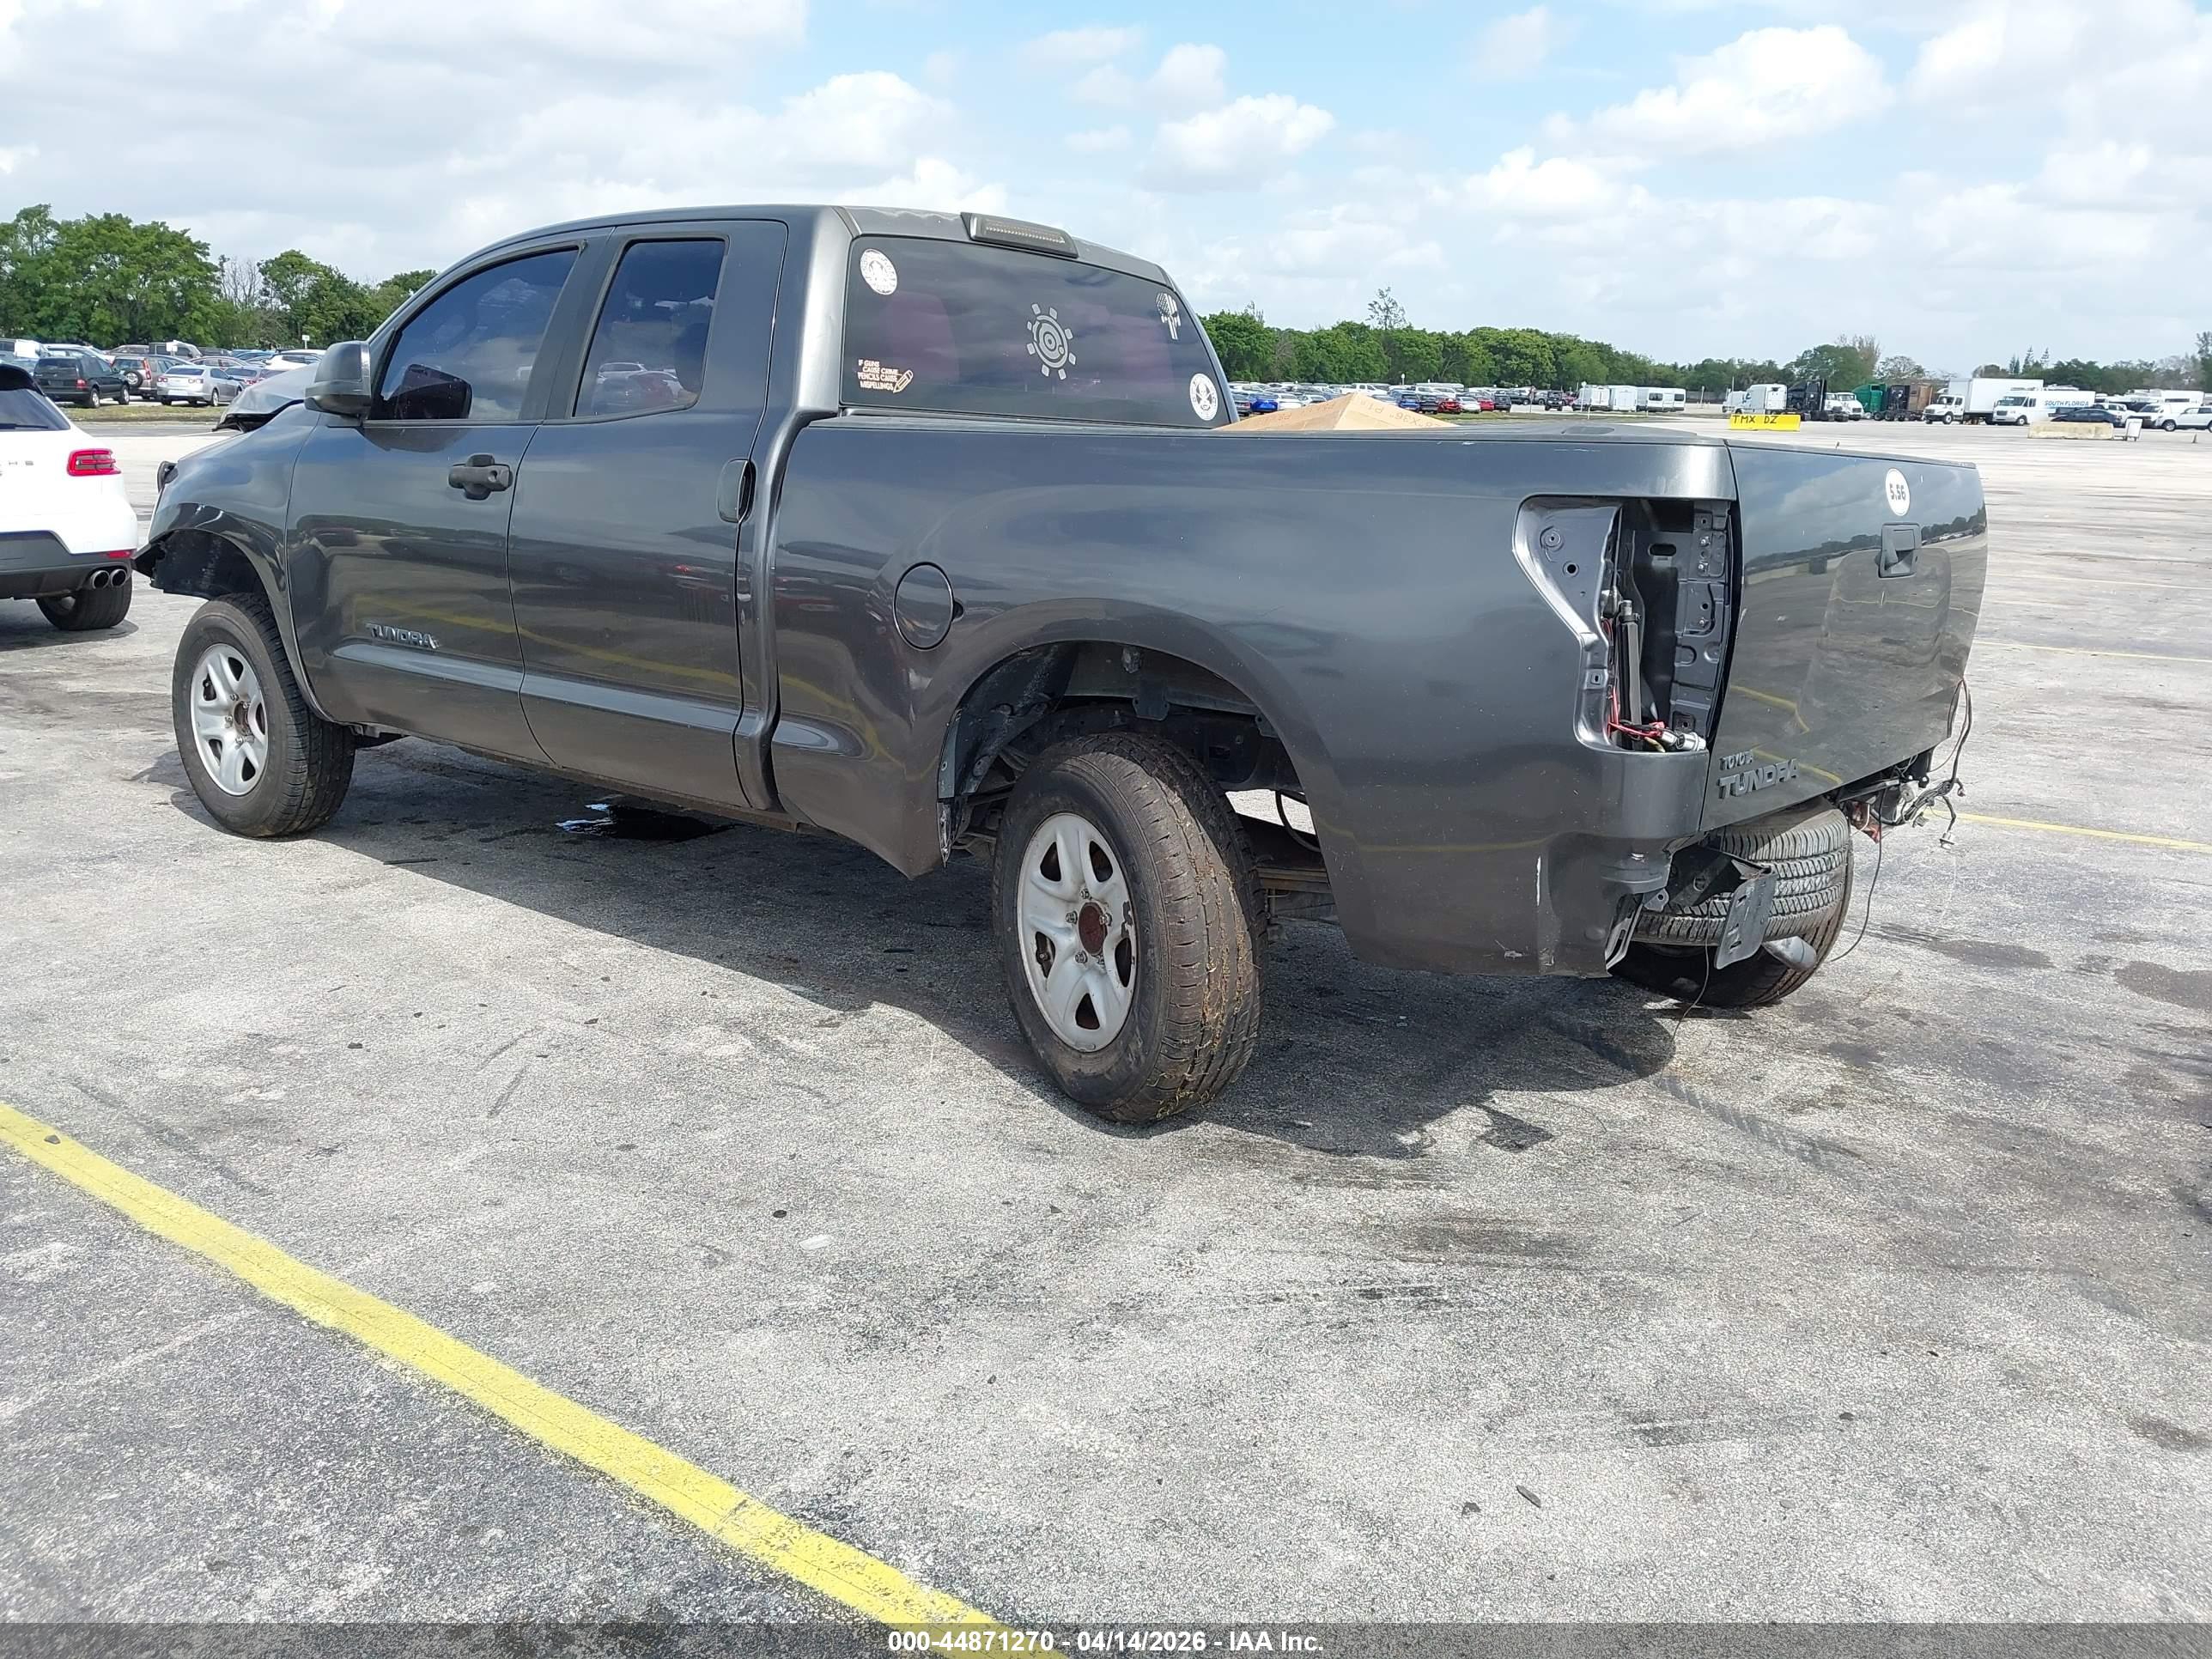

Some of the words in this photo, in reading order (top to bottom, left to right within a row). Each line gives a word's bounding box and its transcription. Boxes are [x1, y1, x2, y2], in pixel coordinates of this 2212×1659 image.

[857, 372, 880, 380] PENCILS
[880, 374, 898, 383] CAUSE
[1732, 415, 1756, 423] TMX
[1889, 483, 1906, 501] 5.56
[365, 623, 440, 649] TUNDRA
[1717, 757, 1800, 799] TUNDRA
